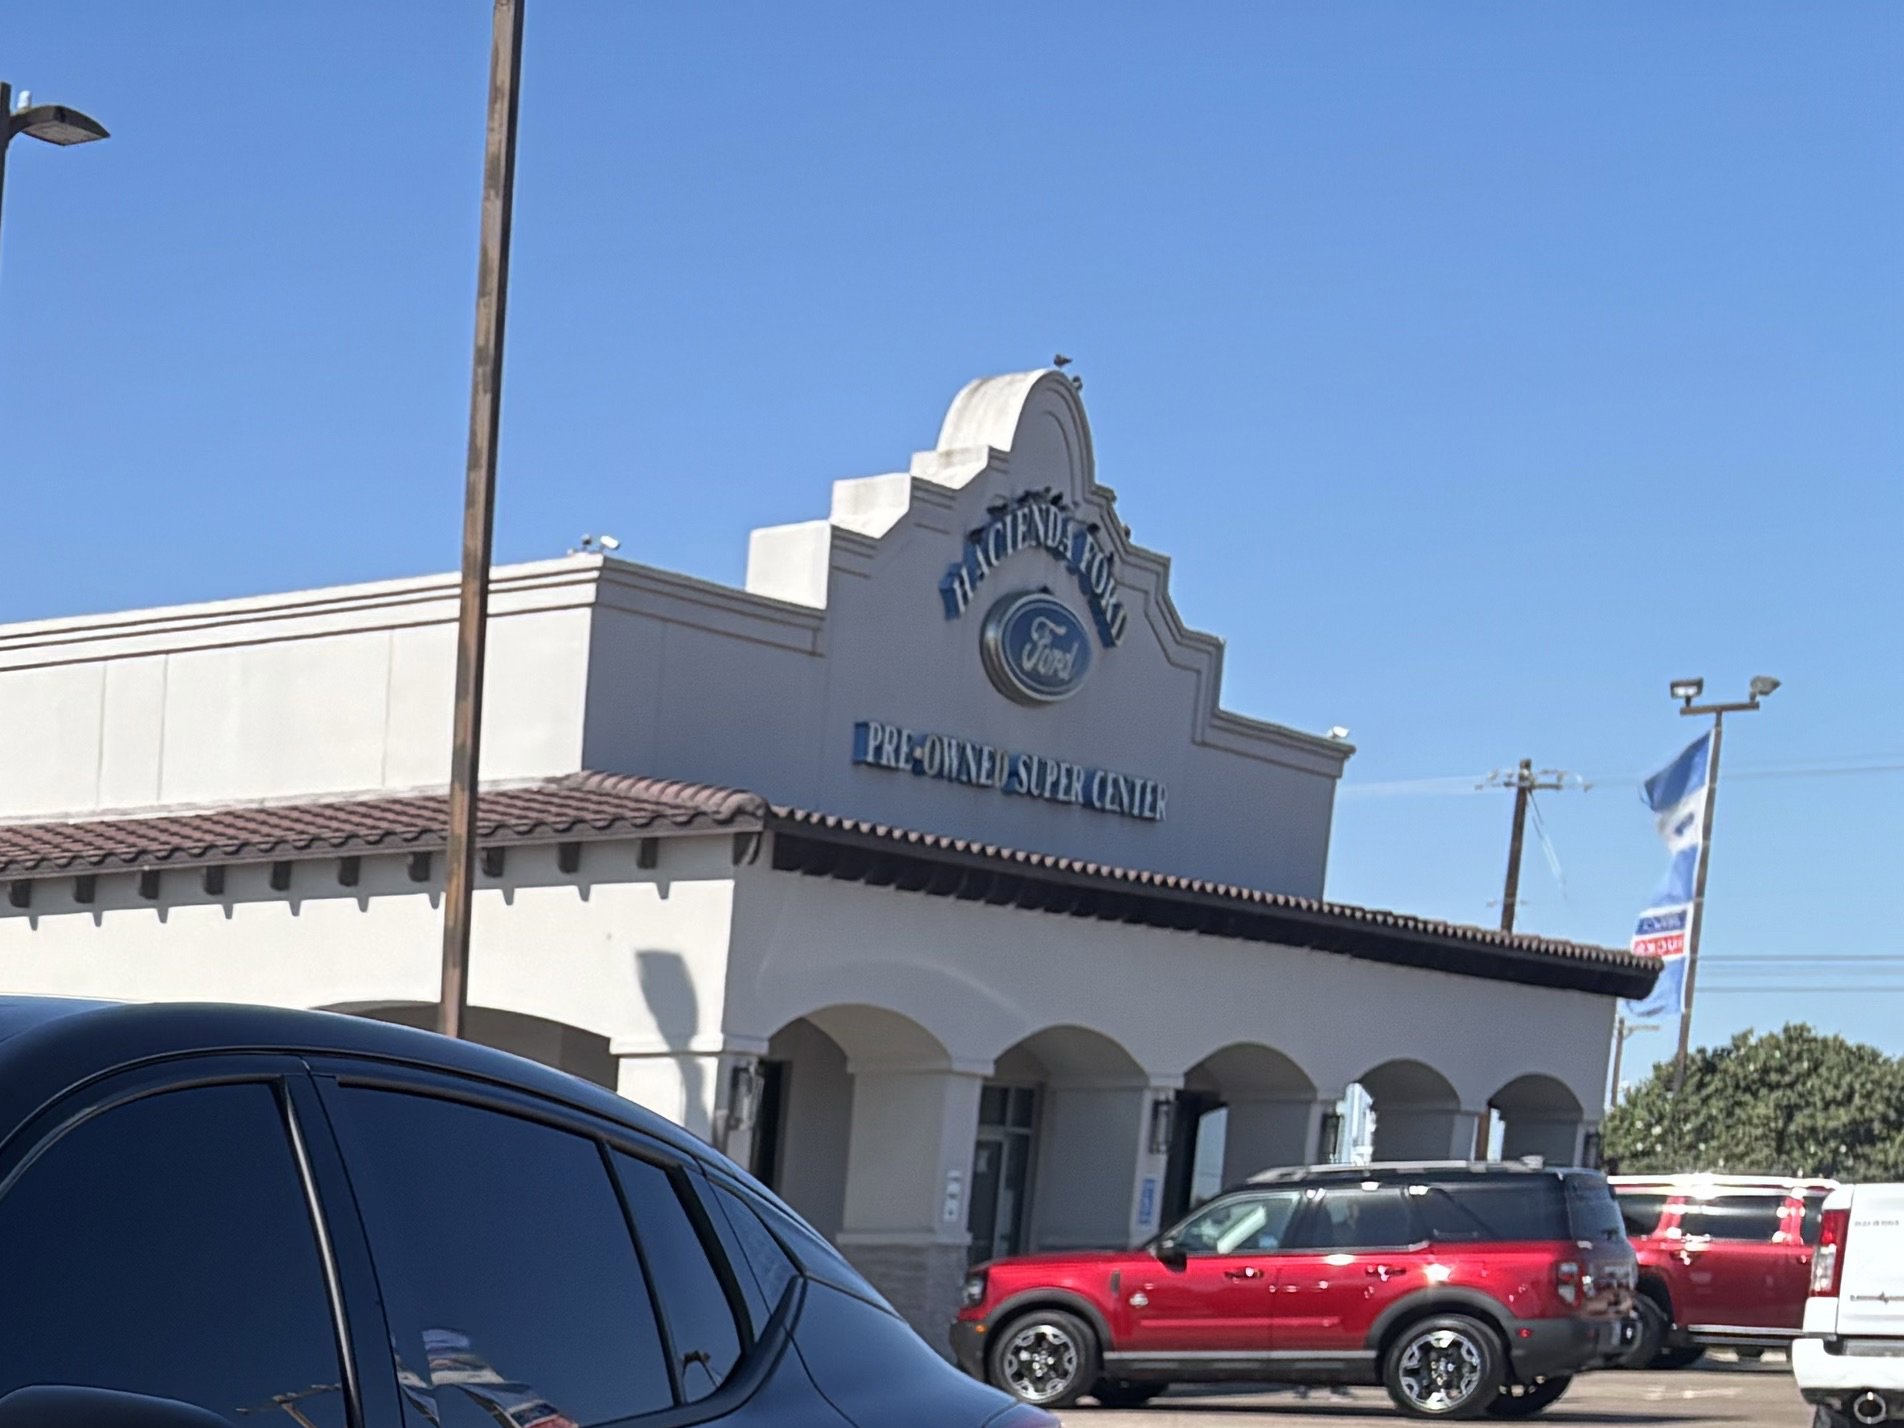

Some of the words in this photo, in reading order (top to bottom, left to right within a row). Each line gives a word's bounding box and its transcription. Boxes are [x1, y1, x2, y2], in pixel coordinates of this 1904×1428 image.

[1021, 615, 1080, 681] Ford
[1014, 753, 1085, 806] SUPER
[1091, 769, 1169, 821] CENTER
